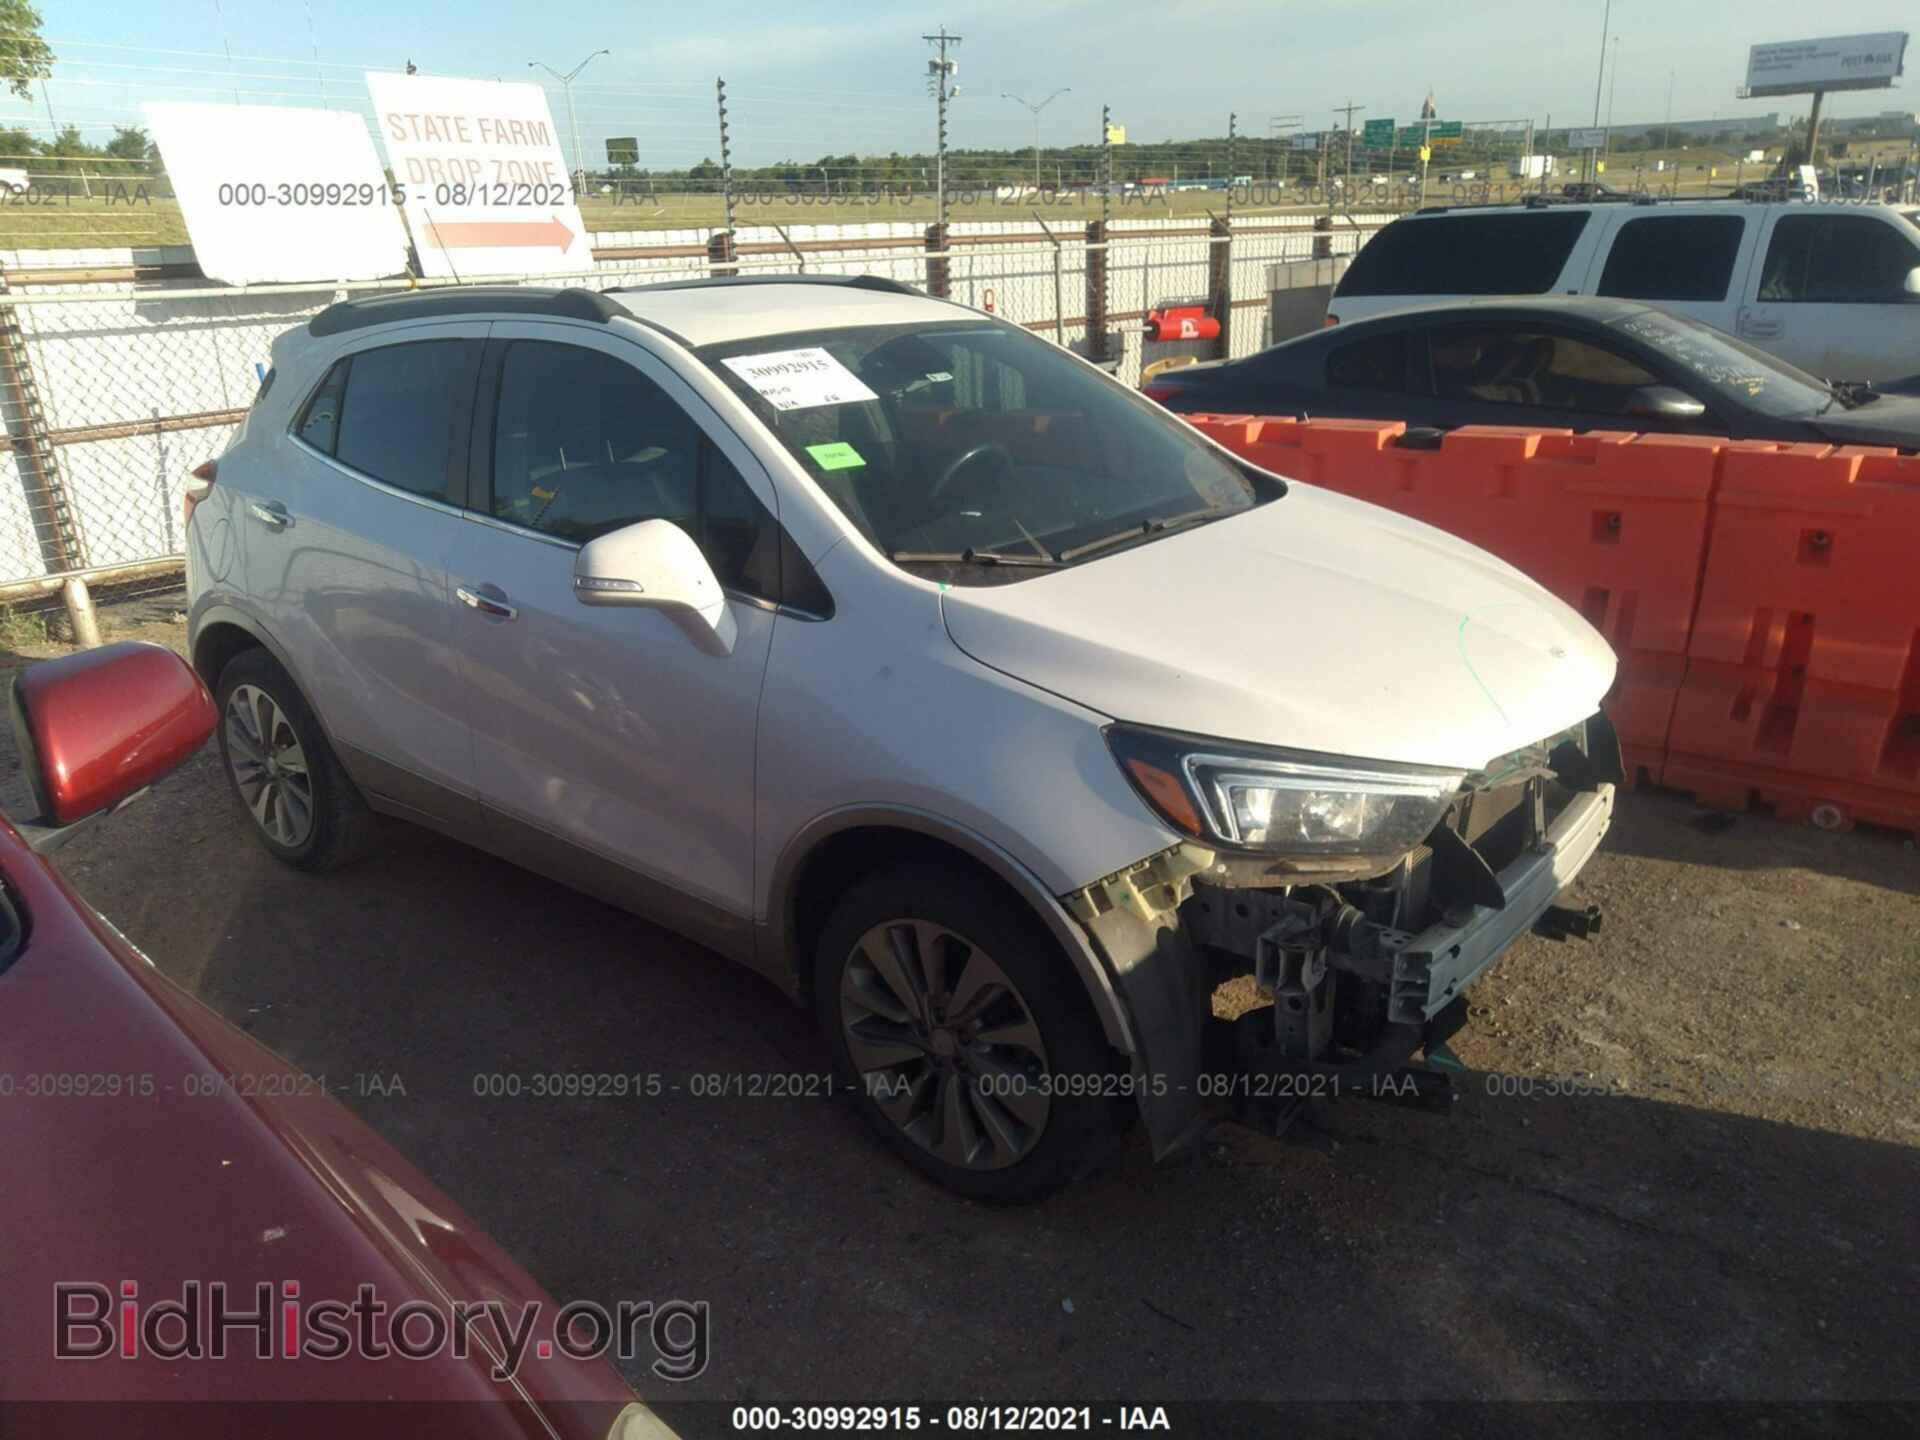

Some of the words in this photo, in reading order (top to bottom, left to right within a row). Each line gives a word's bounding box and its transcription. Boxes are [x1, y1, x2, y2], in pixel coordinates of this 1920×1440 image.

[387, 112, 473, 144] STATE
[478, 116, 552, 147] FARM
[404, 155, 482, 185] DROP
[489, 158, 558, 187] ZONE
